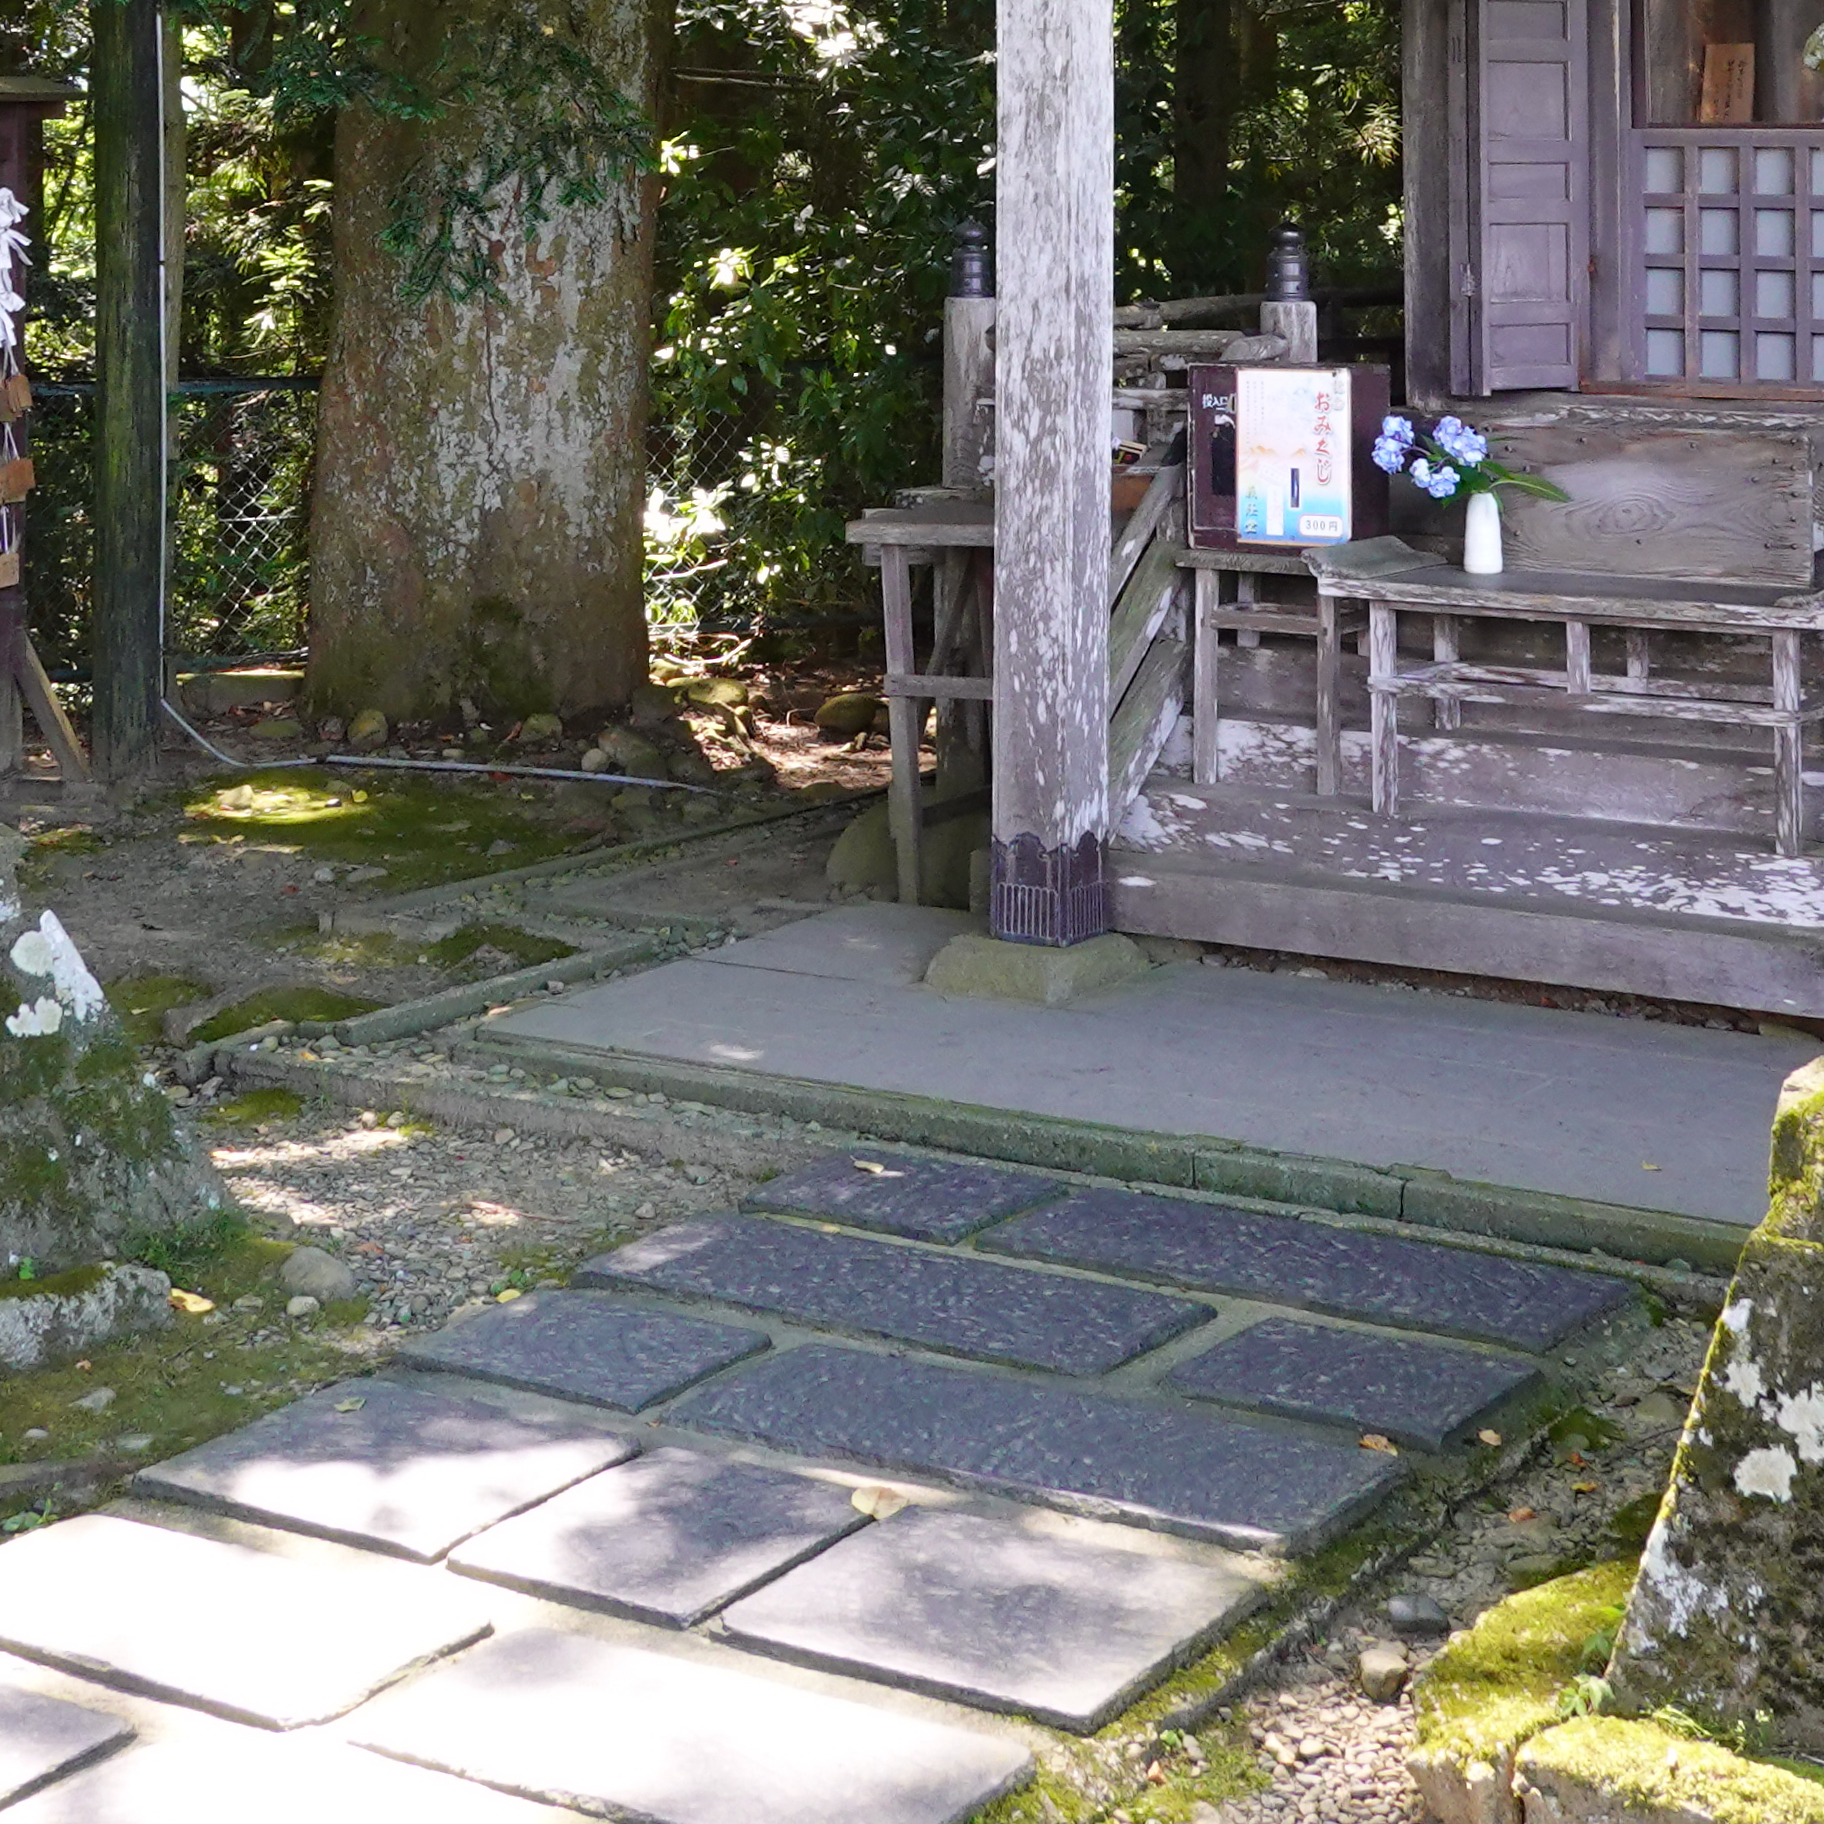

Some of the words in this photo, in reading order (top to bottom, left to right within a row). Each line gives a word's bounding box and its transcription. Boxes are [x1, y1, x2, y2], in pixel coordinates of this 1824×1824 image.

[1314, 391, 1332, 483] おみくじ
[1306, 519, 1338, 532] 300円
